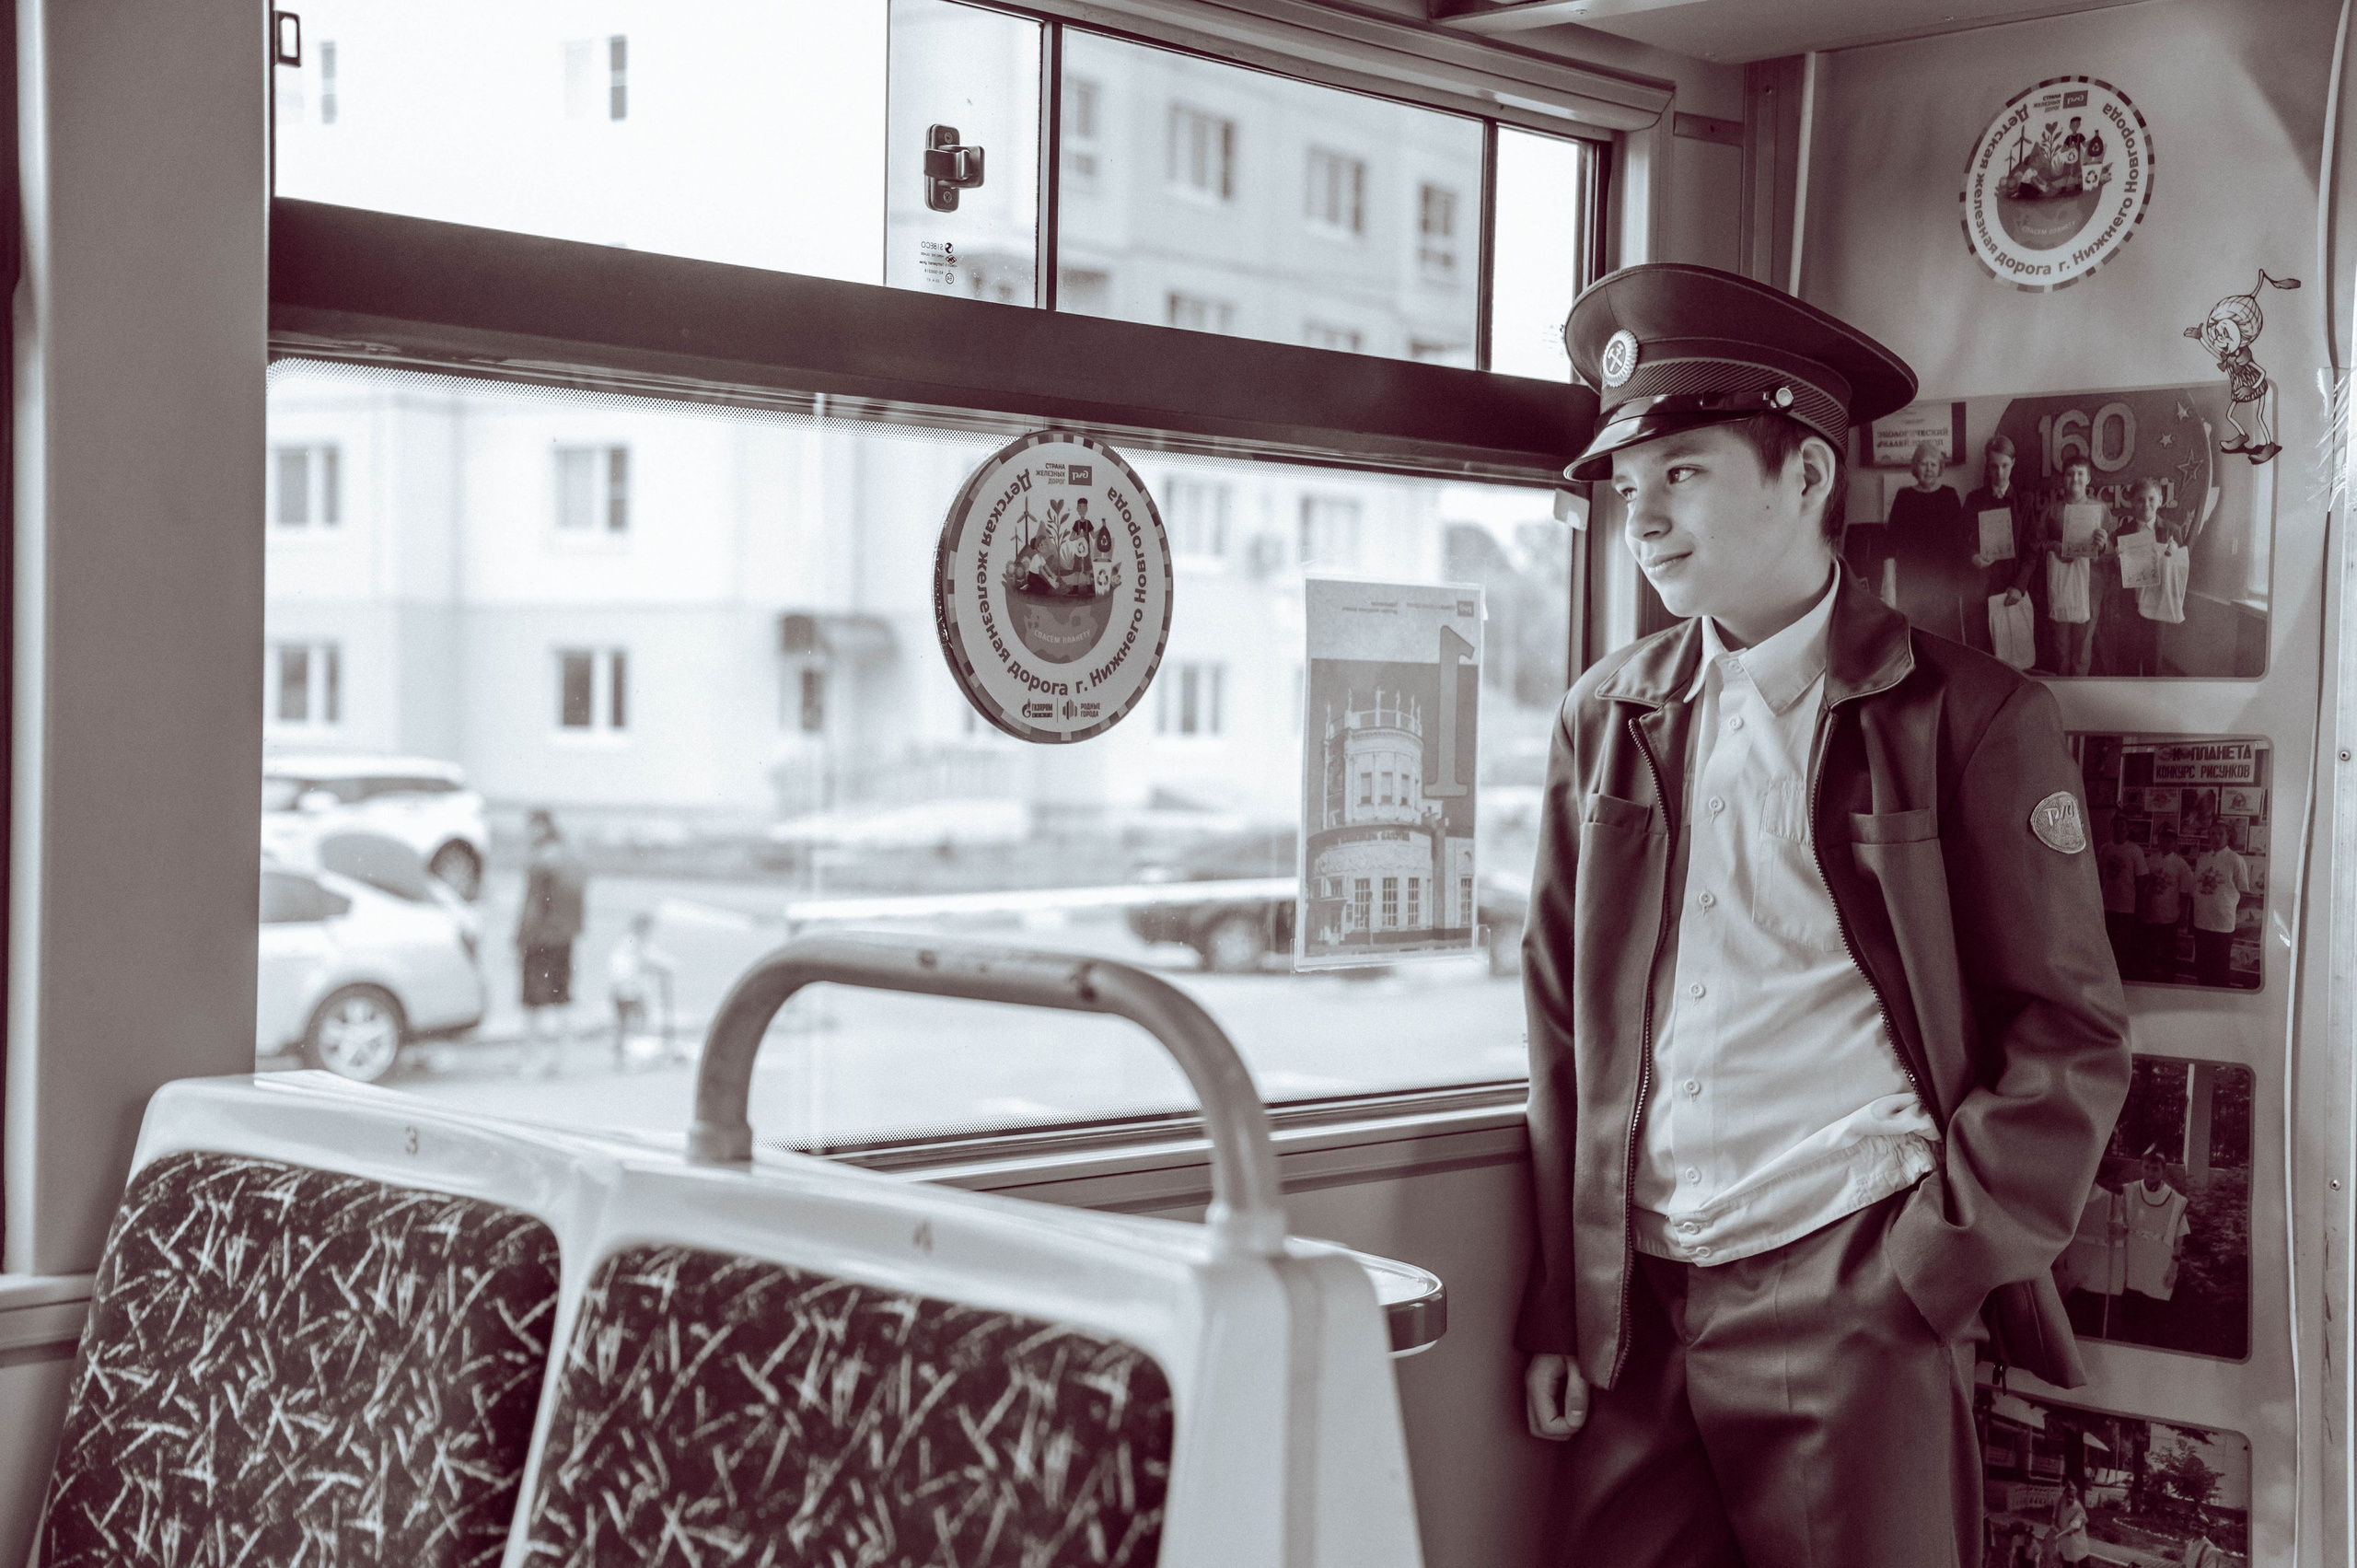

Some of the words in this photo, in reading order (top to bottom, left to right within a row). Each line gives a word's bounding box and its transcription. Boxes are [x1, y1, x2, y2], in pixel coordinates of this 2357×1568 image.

[1980, 103, 2029, 169] Детская
[2102, 103, 2139, 193] Новгорода
[1974, 173, 1998, 255] железная
[2073, 198, 2133, 265] Нижнего
[1994, 251, 2051, 275] дорога
[2059, 261, 2070, 272] г.
[1877, 427, 1948, 437] ЭКОЛОГЧЕСКИЙ
[2038, 402, 2137, 477] 160
[981, 469, 1032, 547] Детская
[1107, 486, 1147, 603] Новгорода
[977, 550, 1011, 663] железная
[1007, 660, 1068, 695] дорога
[1089, 609, 1143, 687] Нижнего
[1076, 680, 1088, 693] г.
[2155, 765, 2195, 779] КОНКУРС
[2200, 764, 2250, 778] РИСУНКОВ
[405, 1125, 418, 1157] 3
